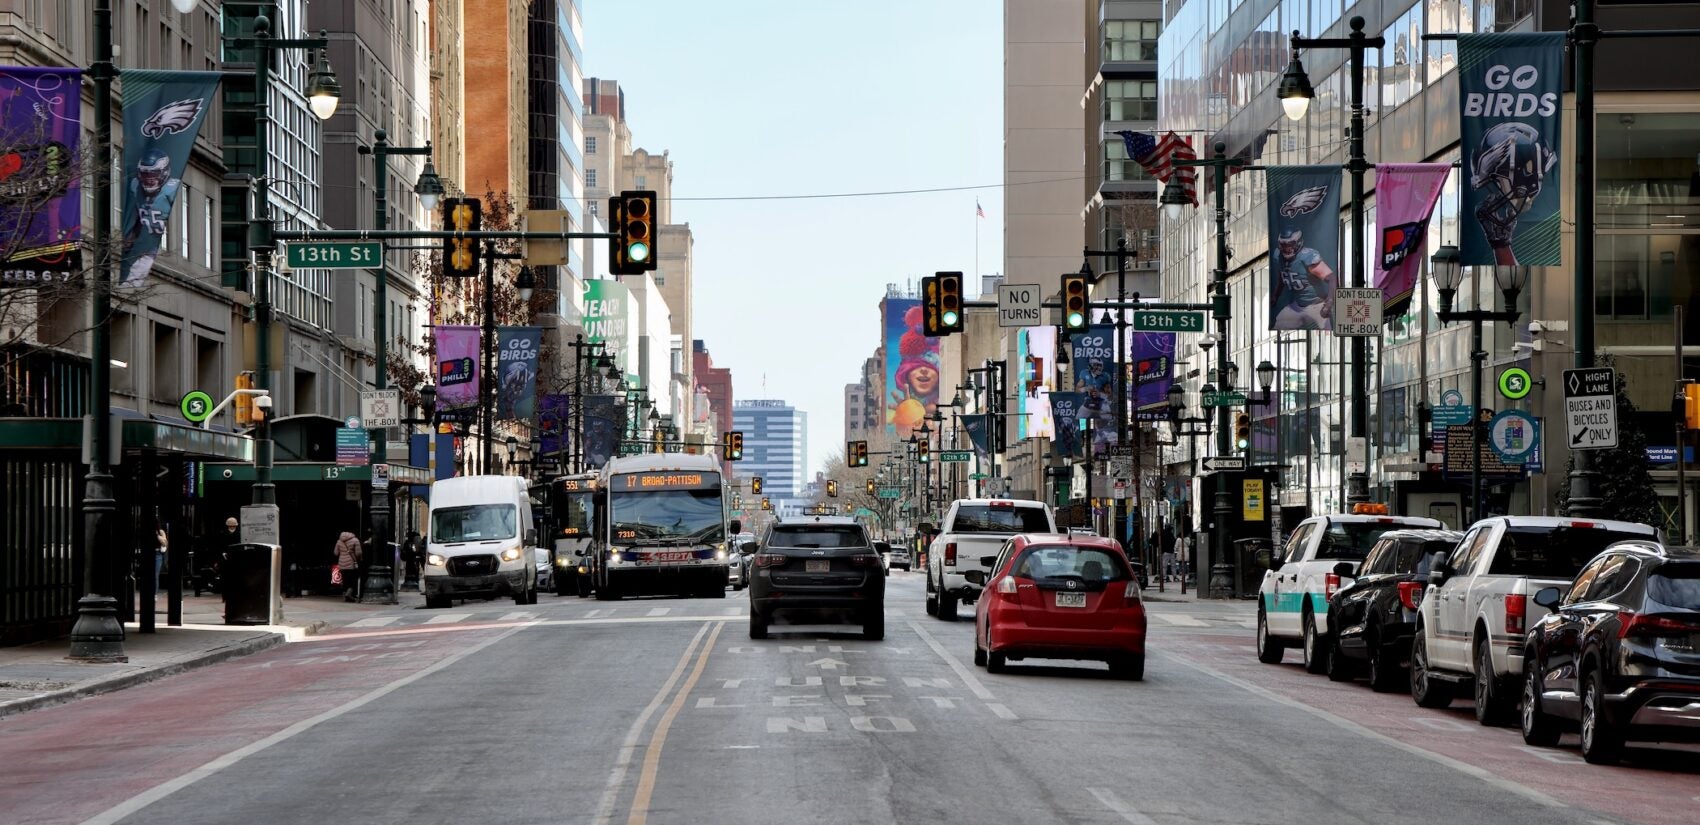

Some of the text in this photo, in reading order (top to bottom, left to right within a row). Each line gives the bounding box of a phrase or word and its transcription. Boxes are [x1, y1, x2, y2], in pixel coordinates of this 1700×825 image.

[1485, 64, 1538, 90] GO
[1463, 92, 1558, 117] BIRDS
[138, 208, 166, 234] 65
[298, 247, 372, 261] 13th St
[4, 270, 70, 283] FEB 67
[1280, 271, 1304, 291] 65
[1009, 290, 1030, 304] NO
[1357, 290, 1380, 299] BLOCK
[1001, 308, 1039, 320] TURNS
[1142, 315, 1196, 327] 13th St
[1338, 323, 1379, 334] THE BOX
[508, 338, 531, 348] GO
[1081, 336, 1104, 347] GO
[500, 349, 537, 360] BIRDS
[1074, 347, 1112, 359] BIRDS
[442, 372, 470, 382] PHILLY
[1139, 370, 1166, 382] PHILLY
[1585, 372, 1610, 382] RIGHT
[1586, 383, 1609, 393] LANE
[379, 391, 397, 399] BLOCK
[1056, 400, 1073, 409] GO
[1569, 399, 1611, 412] BUSES AND
[365, 418, 397, 427] THE BOX
[1573, 412, 1609, 426] BICYCLES
[1589, 428, 1612, 440] ONLY
[565, 481, 578, 490] 551
[627, 474, 703, 487] 17 BROAD-PATTISON
[618, 530, 636, 538] 7310
[660, 552, 694, 561] SEPTA
[727, 645, 916, 655] ONLY
[716, 676, 954, 689] TURN
[695, 695, 965, 709] LEFT
[766, 715, 918, 733] NO
